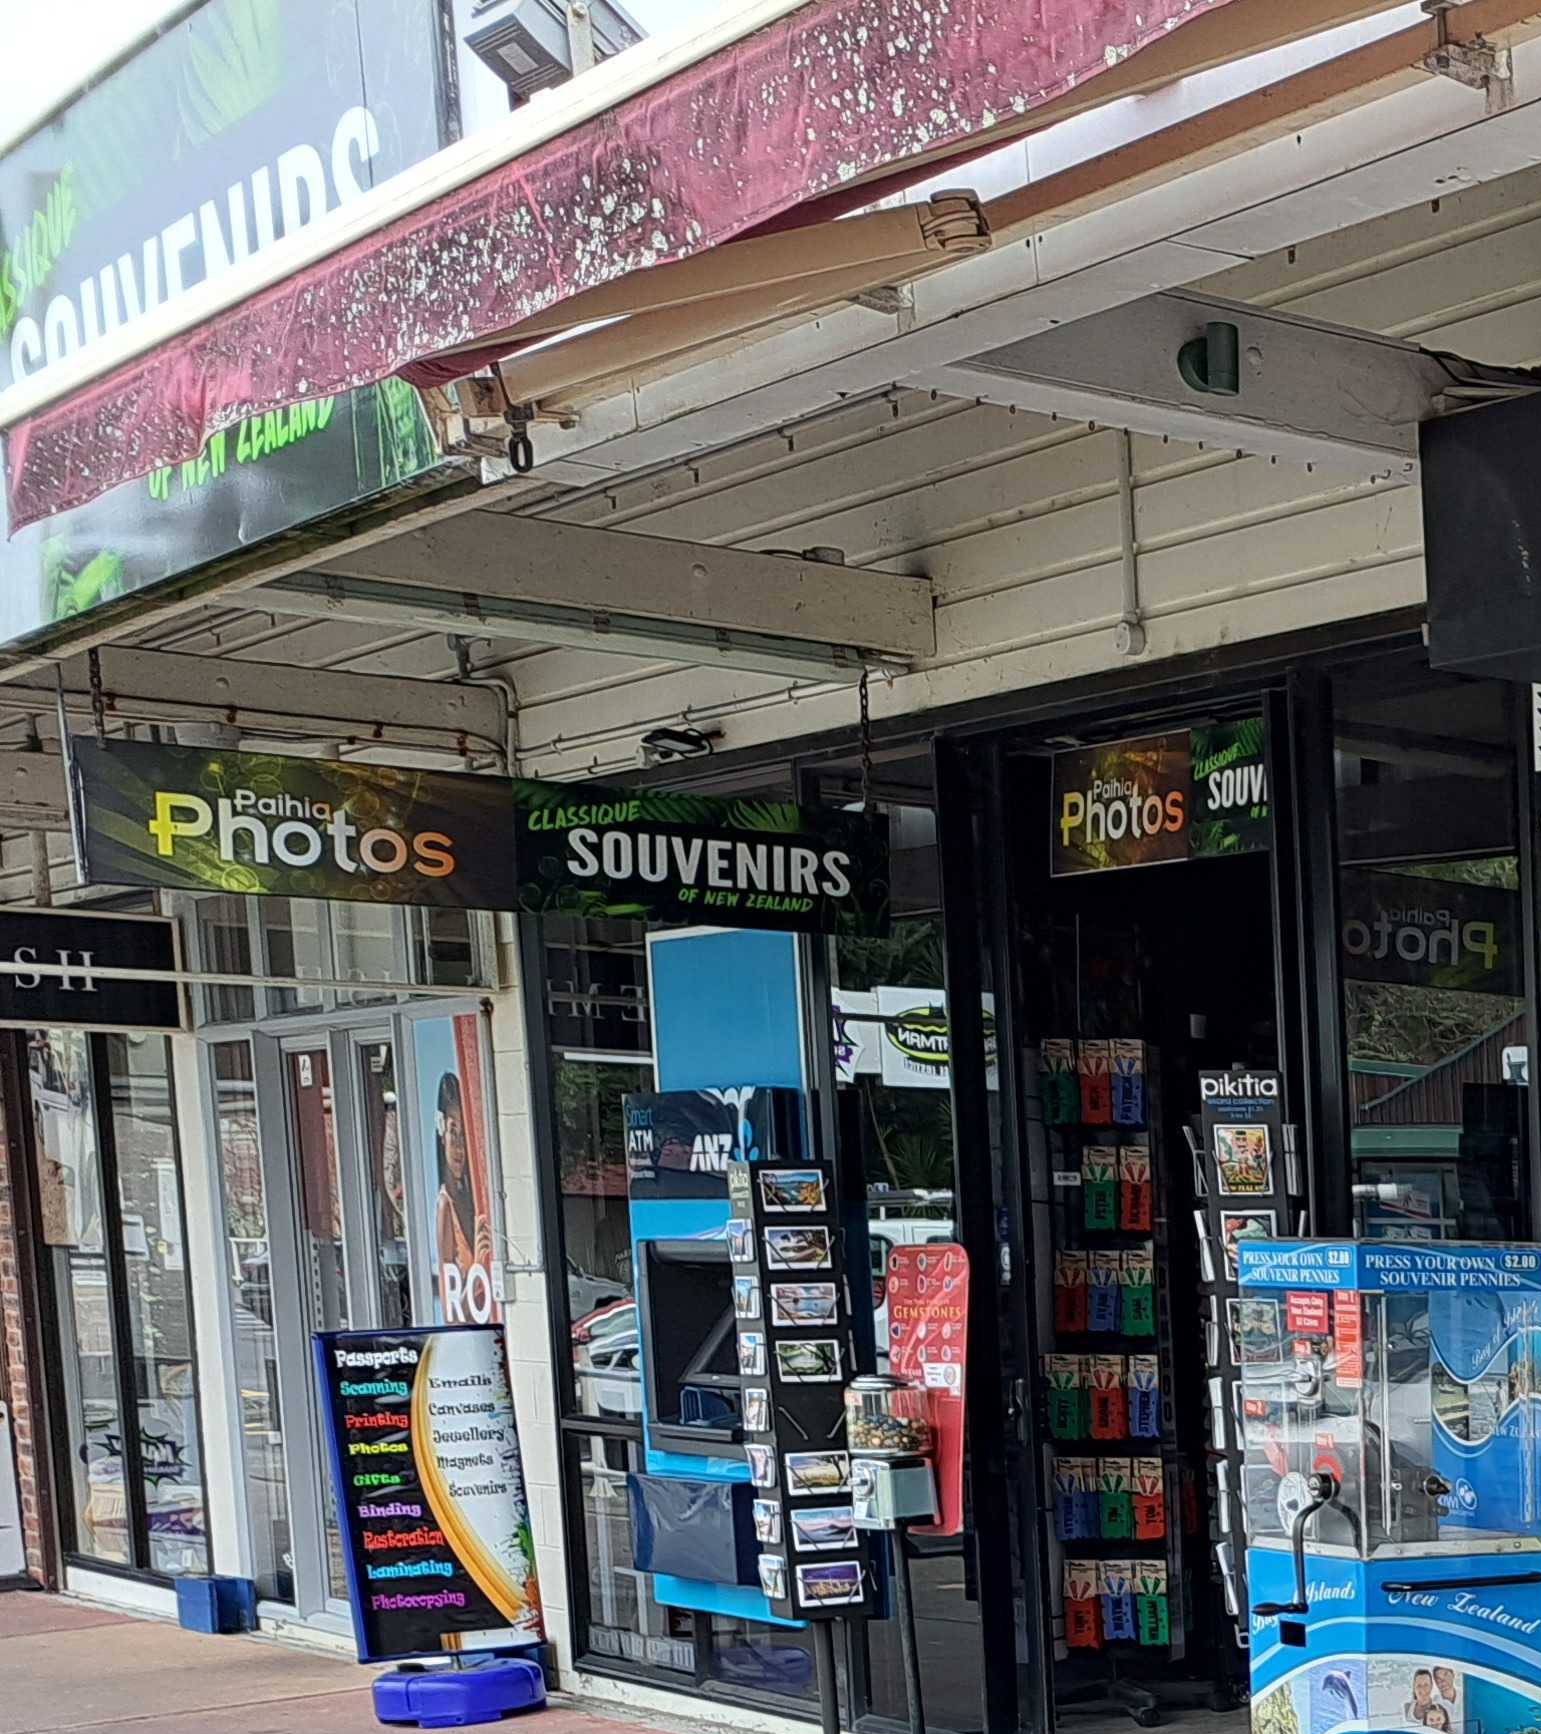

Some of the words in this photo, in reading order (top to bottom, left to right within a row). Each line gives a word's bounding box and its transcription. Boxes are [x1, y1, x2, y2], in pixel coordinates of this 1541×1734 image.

[1093, 778, 1133, 800] Paihia
[233, 788, 332, 821] Paihia
[528, 799, 642, 831] CLASSIQUE
[1060, 783, 1185, 846] Photos
[148, 791, 457, 878] Photos
[567, 828, 851, 898] SOUVENIRS
[678, 888, 691, 904] OF
[704, 890, 740, 907] NEW
[748, 894, 814, 914] ZEALAND
[1201, 1073, 1279, 1100] pikitia
[628, 1129, 653, 1152] ATM
[689, 1133, 733, 1172] ANZ
[1243, 1250, 1271, 1265] PRESS
[1272, 1251, 1299, 1266] YOUR
[1301, 1252, 1323, 1267] OWN
[1366, 1254, 1412, 1269] PRESS
[1416, 1255, 1458, 1270] YOUR
[1460, 1257, 1495, 1272] OWN
[1504, 1255, 1537, 1269] $2.00
[1251, 1268, 1299, 1282] SOUVENIR
[1300, 1268, 1340, 1284] PENNIES
[1380, 1272, 1457, 1287] SOUVENIR
[1461, 1273, 1521, 1288] PENNIES
[893, 1305, 961, 1319] GEMSTONES
[335, 1348, 419, 1369] Passports
[340, 1379, 409, 1398] Scanning
[429, 1374, 492, 1389] Emails
[429, 1400, 496, 1417] Canvases
[345, 1412, 409, 1429] Printing
[432, 1425, 506, 1446] Jewellery
[348, 1440, 410, 1456] Photos
[437, 1452, 495, 1470] Magnets
[353, 1471, 402, 1488] Gifts
[448, 1480, 508, 1499] Souvenirs
[358, 1503, 422, 1519] Binding
[363, 1527, 446, 1550] Restoration
[366, 1561, 454, 1580] Laminating
[1447, 1591, 1541, 1636] Zealand
